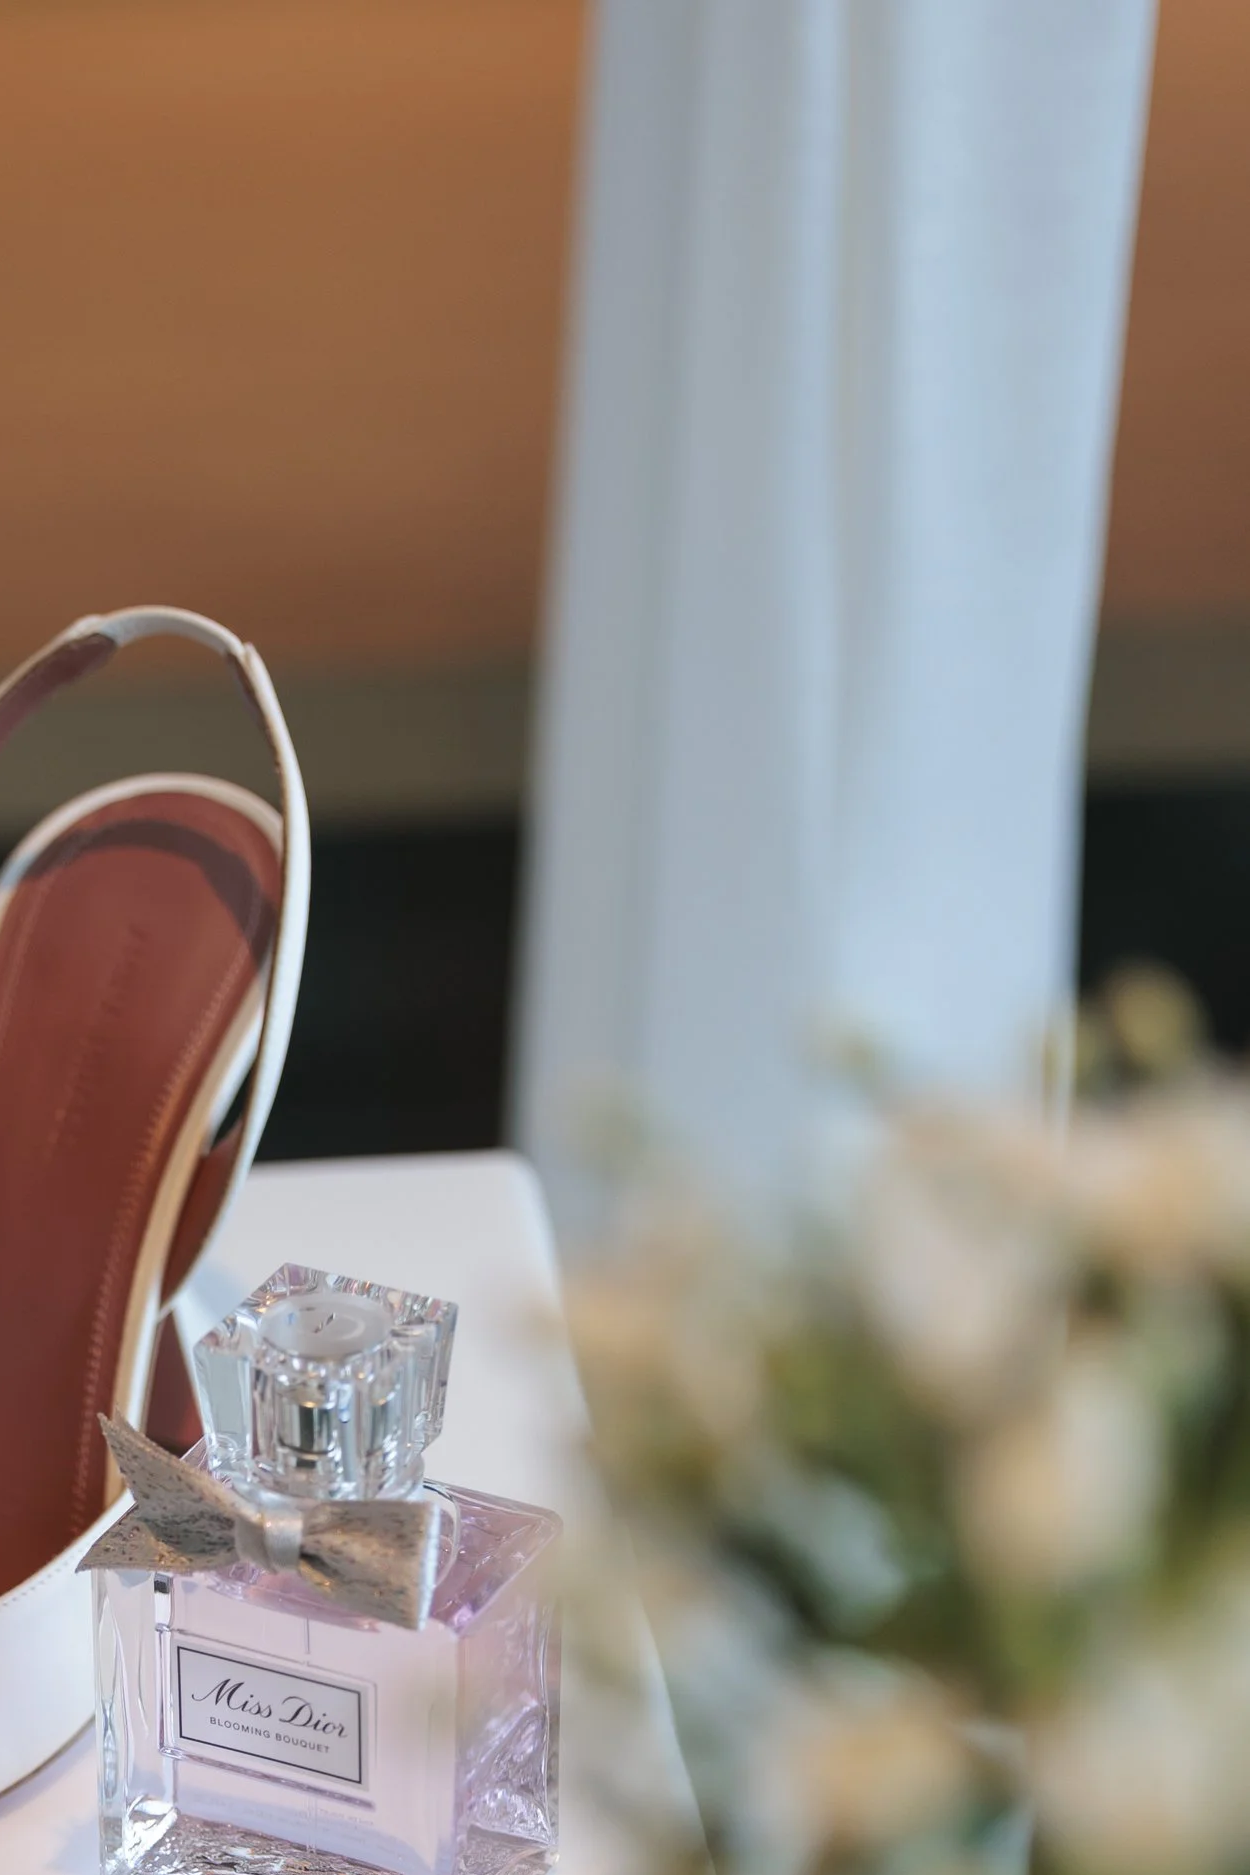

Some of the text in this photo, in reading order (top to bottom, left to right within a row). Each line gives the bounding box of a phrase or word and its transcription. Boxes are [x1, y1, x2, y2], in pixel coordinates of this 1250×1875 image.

[191, 1678, 349, 1739] Miss Dior
[209, 1716, 330, 1754] BLOOMING BOUQUET
